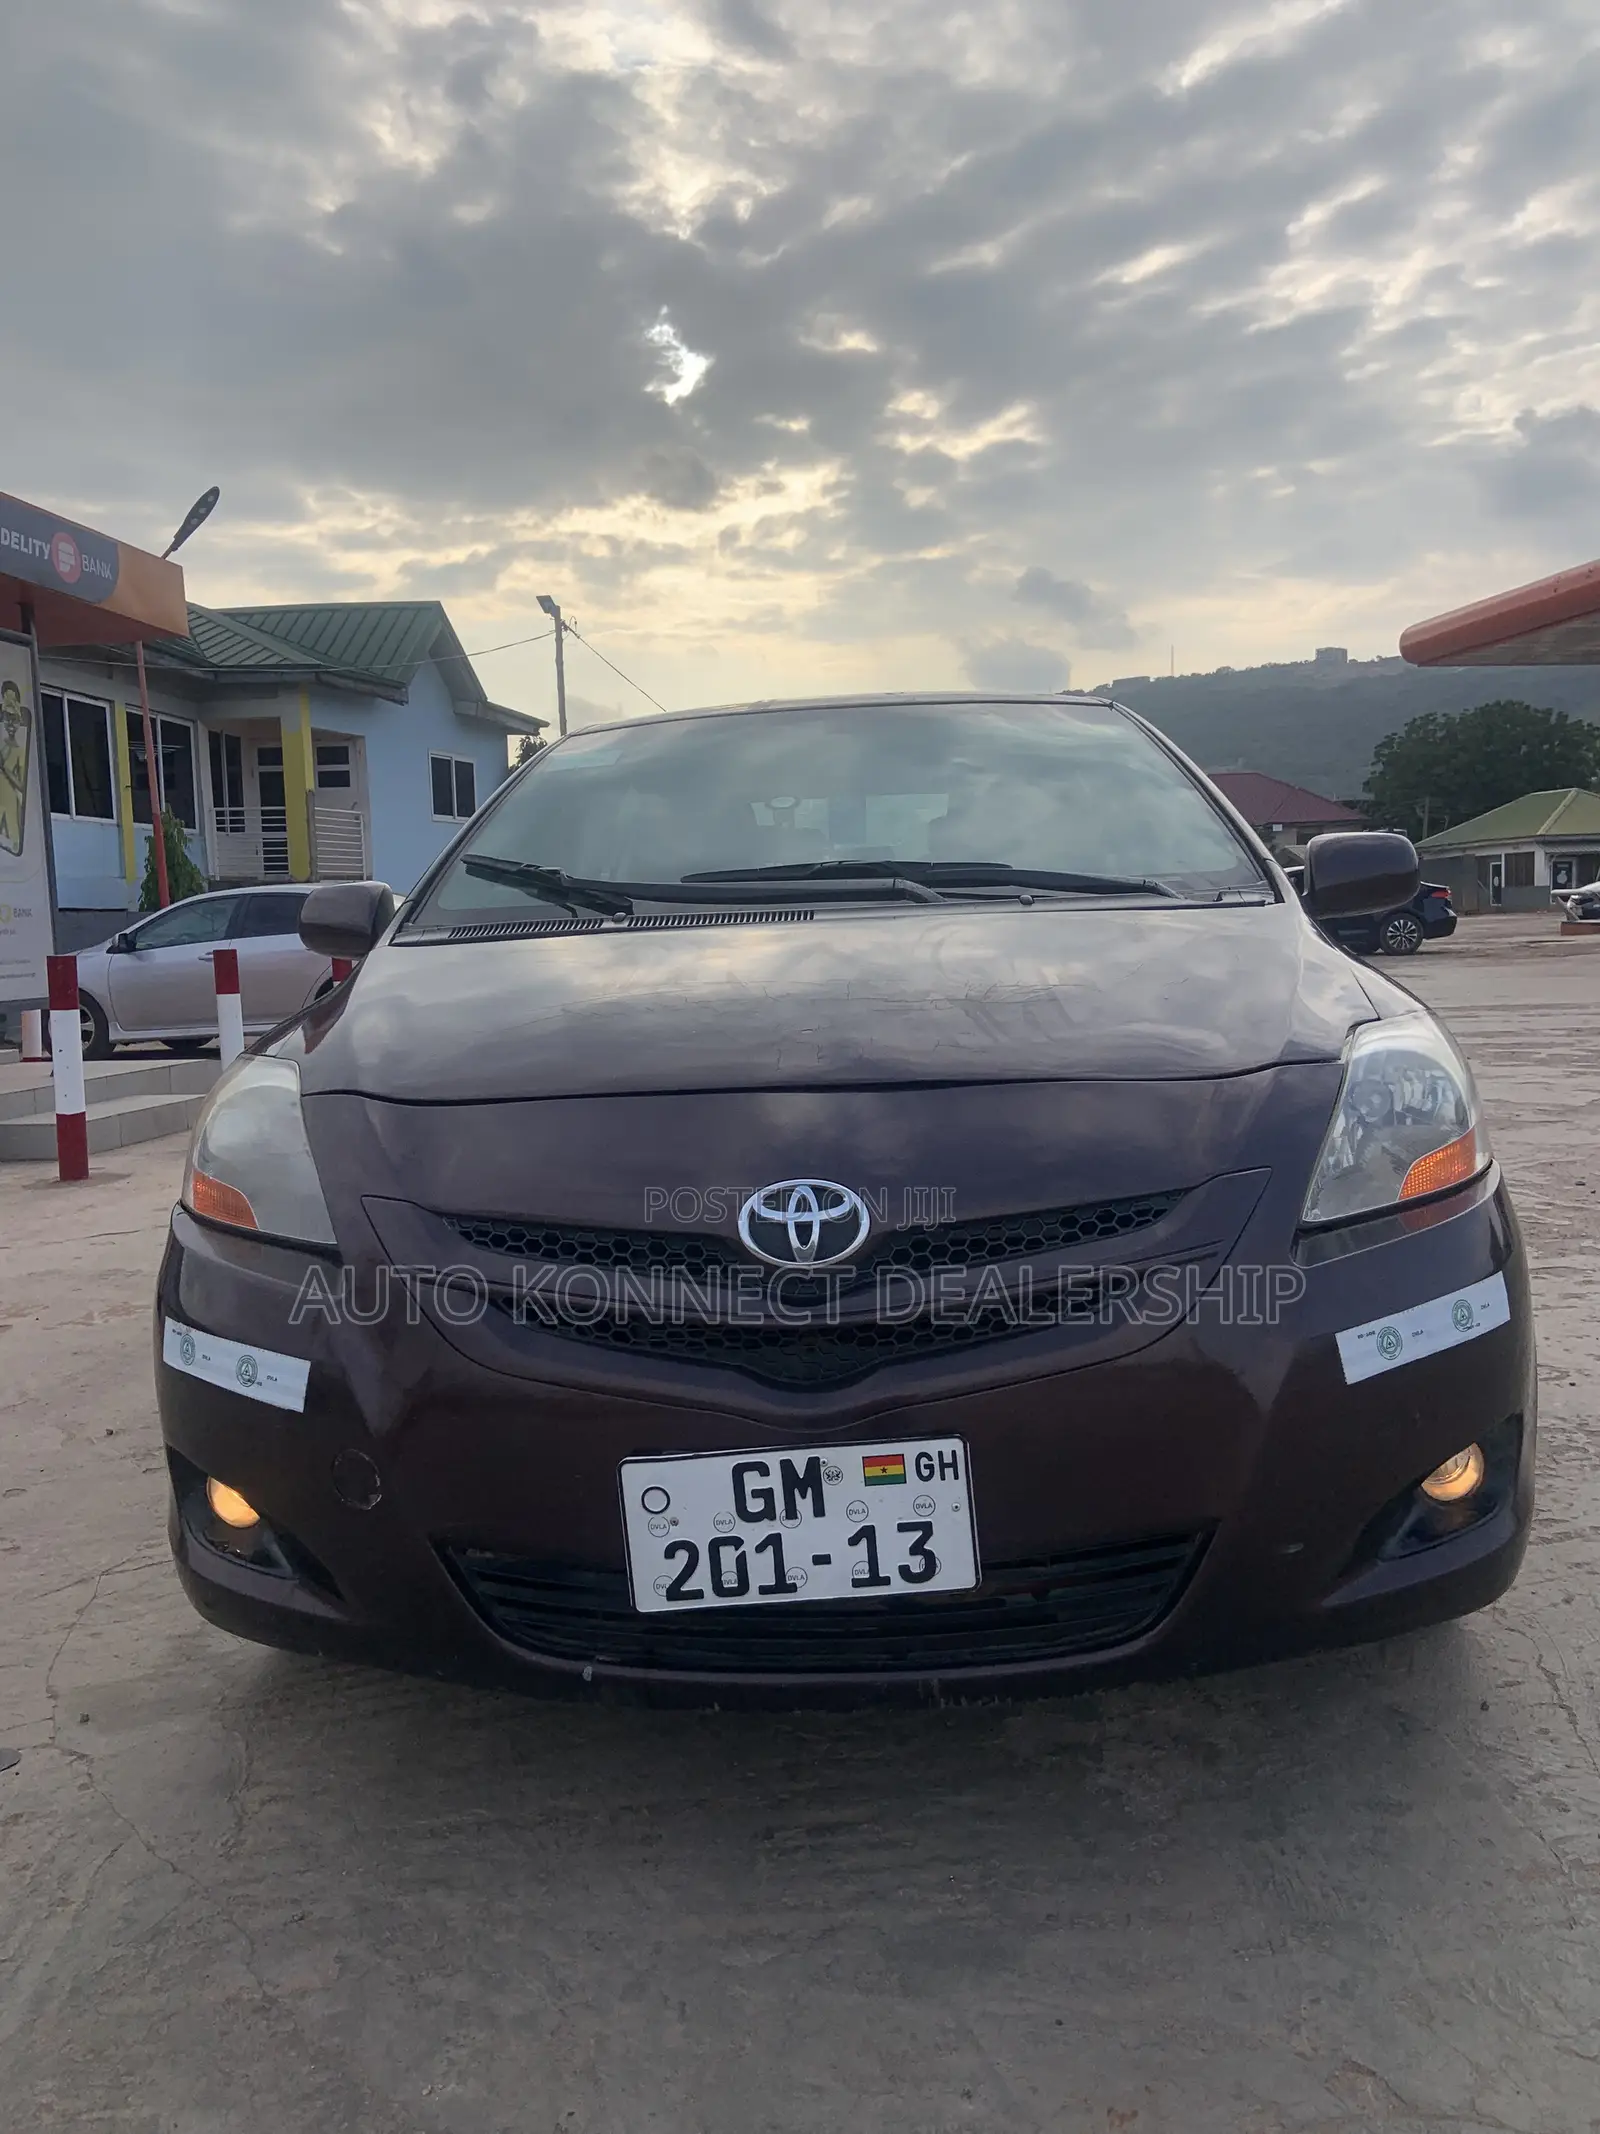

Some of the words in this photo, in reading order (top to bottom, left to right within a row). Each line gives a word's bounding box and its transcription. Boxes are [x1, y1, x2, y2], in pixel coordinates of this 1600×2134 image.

[81, 554, 112, 580] BANK
[915, 1450, 959, 1482] GH
[731, 1456, 826, 1523] GM
[915, 1502, 933, 1510] DVLA
[848, 1508, 866, 1516] DVLA
[650, 1523, 668, 1531] DVLA
[715, 1519, 733, 1527] DVLA
[663, 1520, 938, 1602] 201-13
[787, 1574, 805, 1582] DVLA
